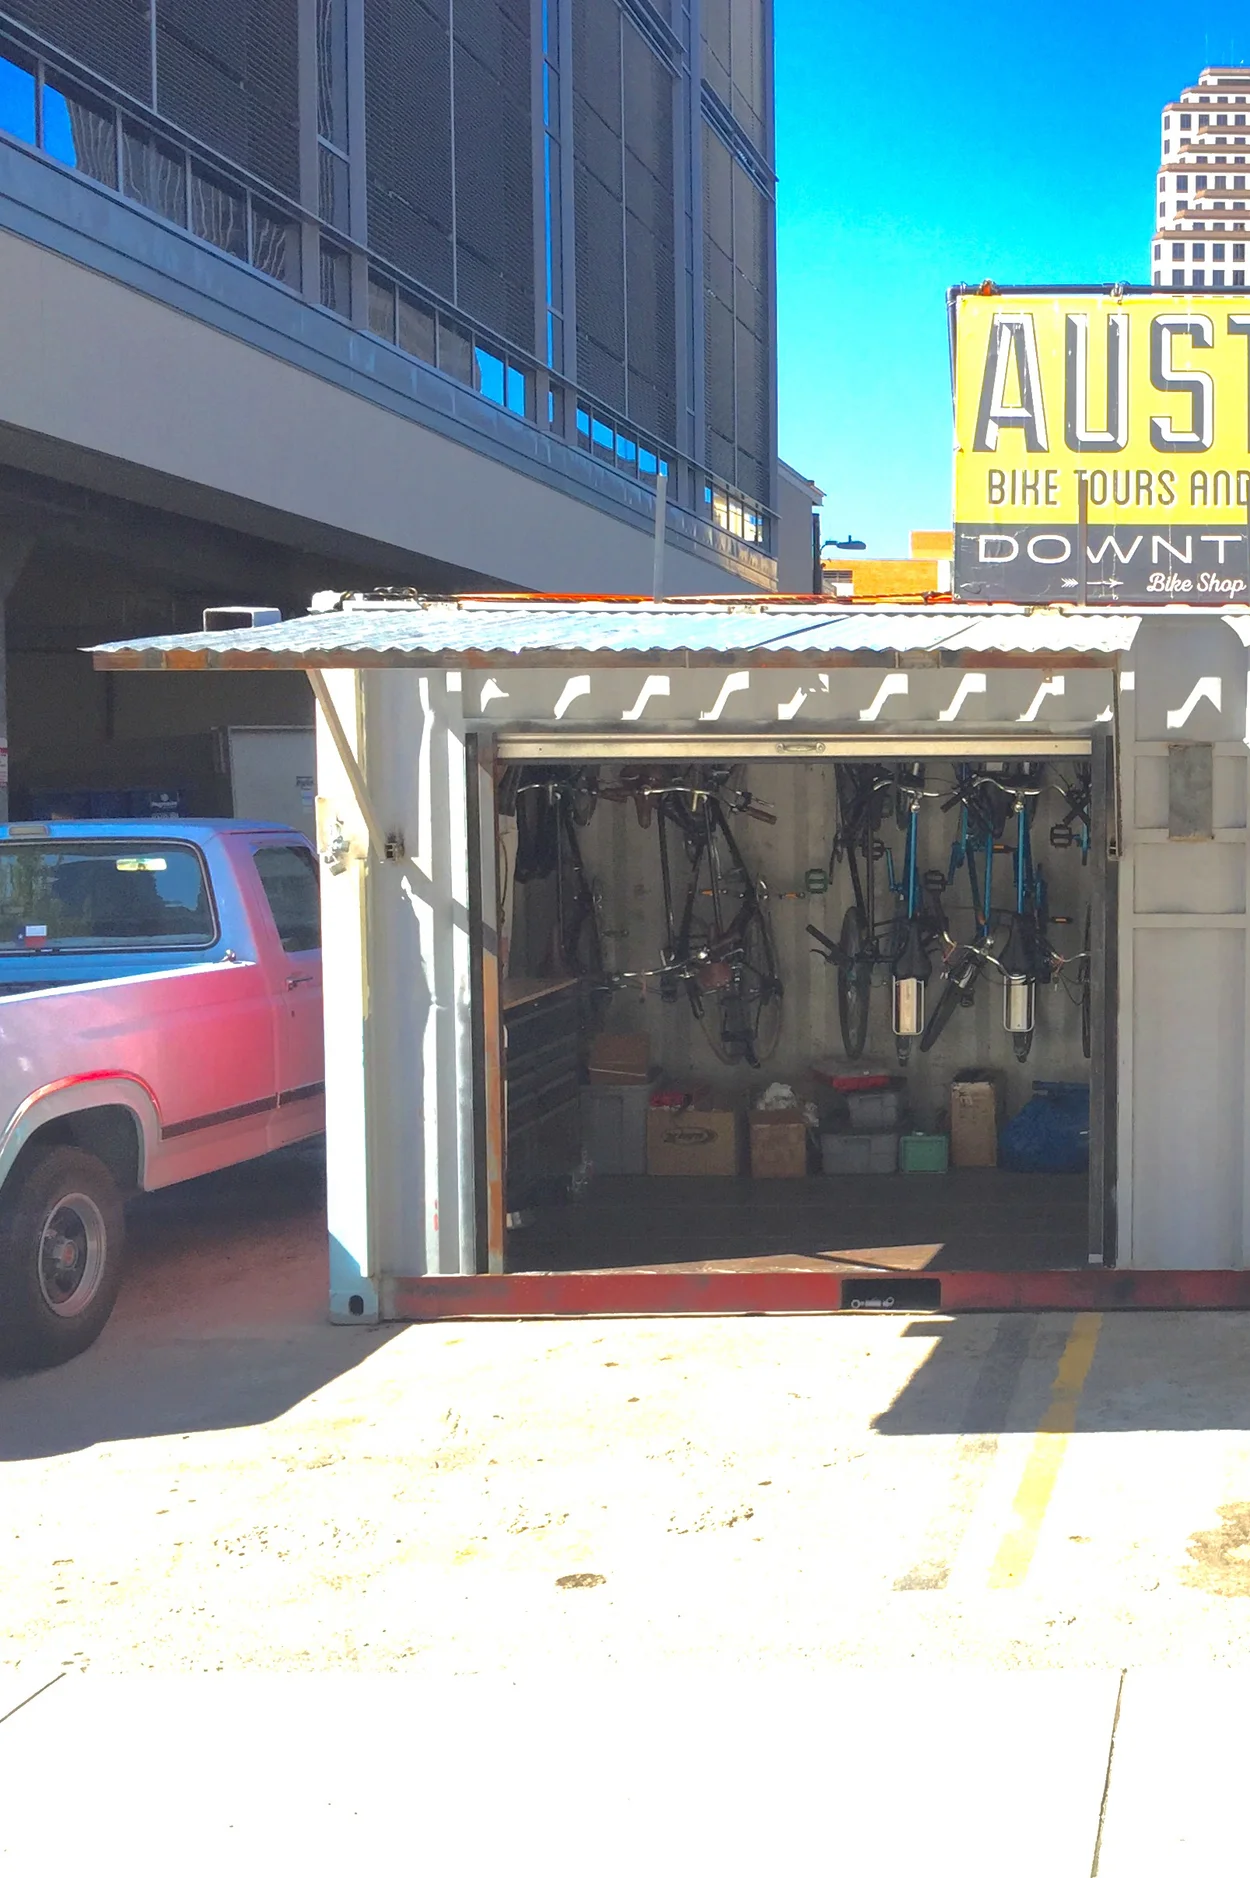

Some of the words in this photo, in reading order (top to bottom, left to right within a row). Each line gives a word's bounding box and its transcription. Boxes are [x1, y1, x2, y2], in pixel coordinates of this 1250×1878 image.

[988, 469, 1058, 506] BIKE
[1073, 469, 1175, 507] TOURS
[1146, 571, 1193, 594] Bike
[1196, 572, 1247, 600] Shop
